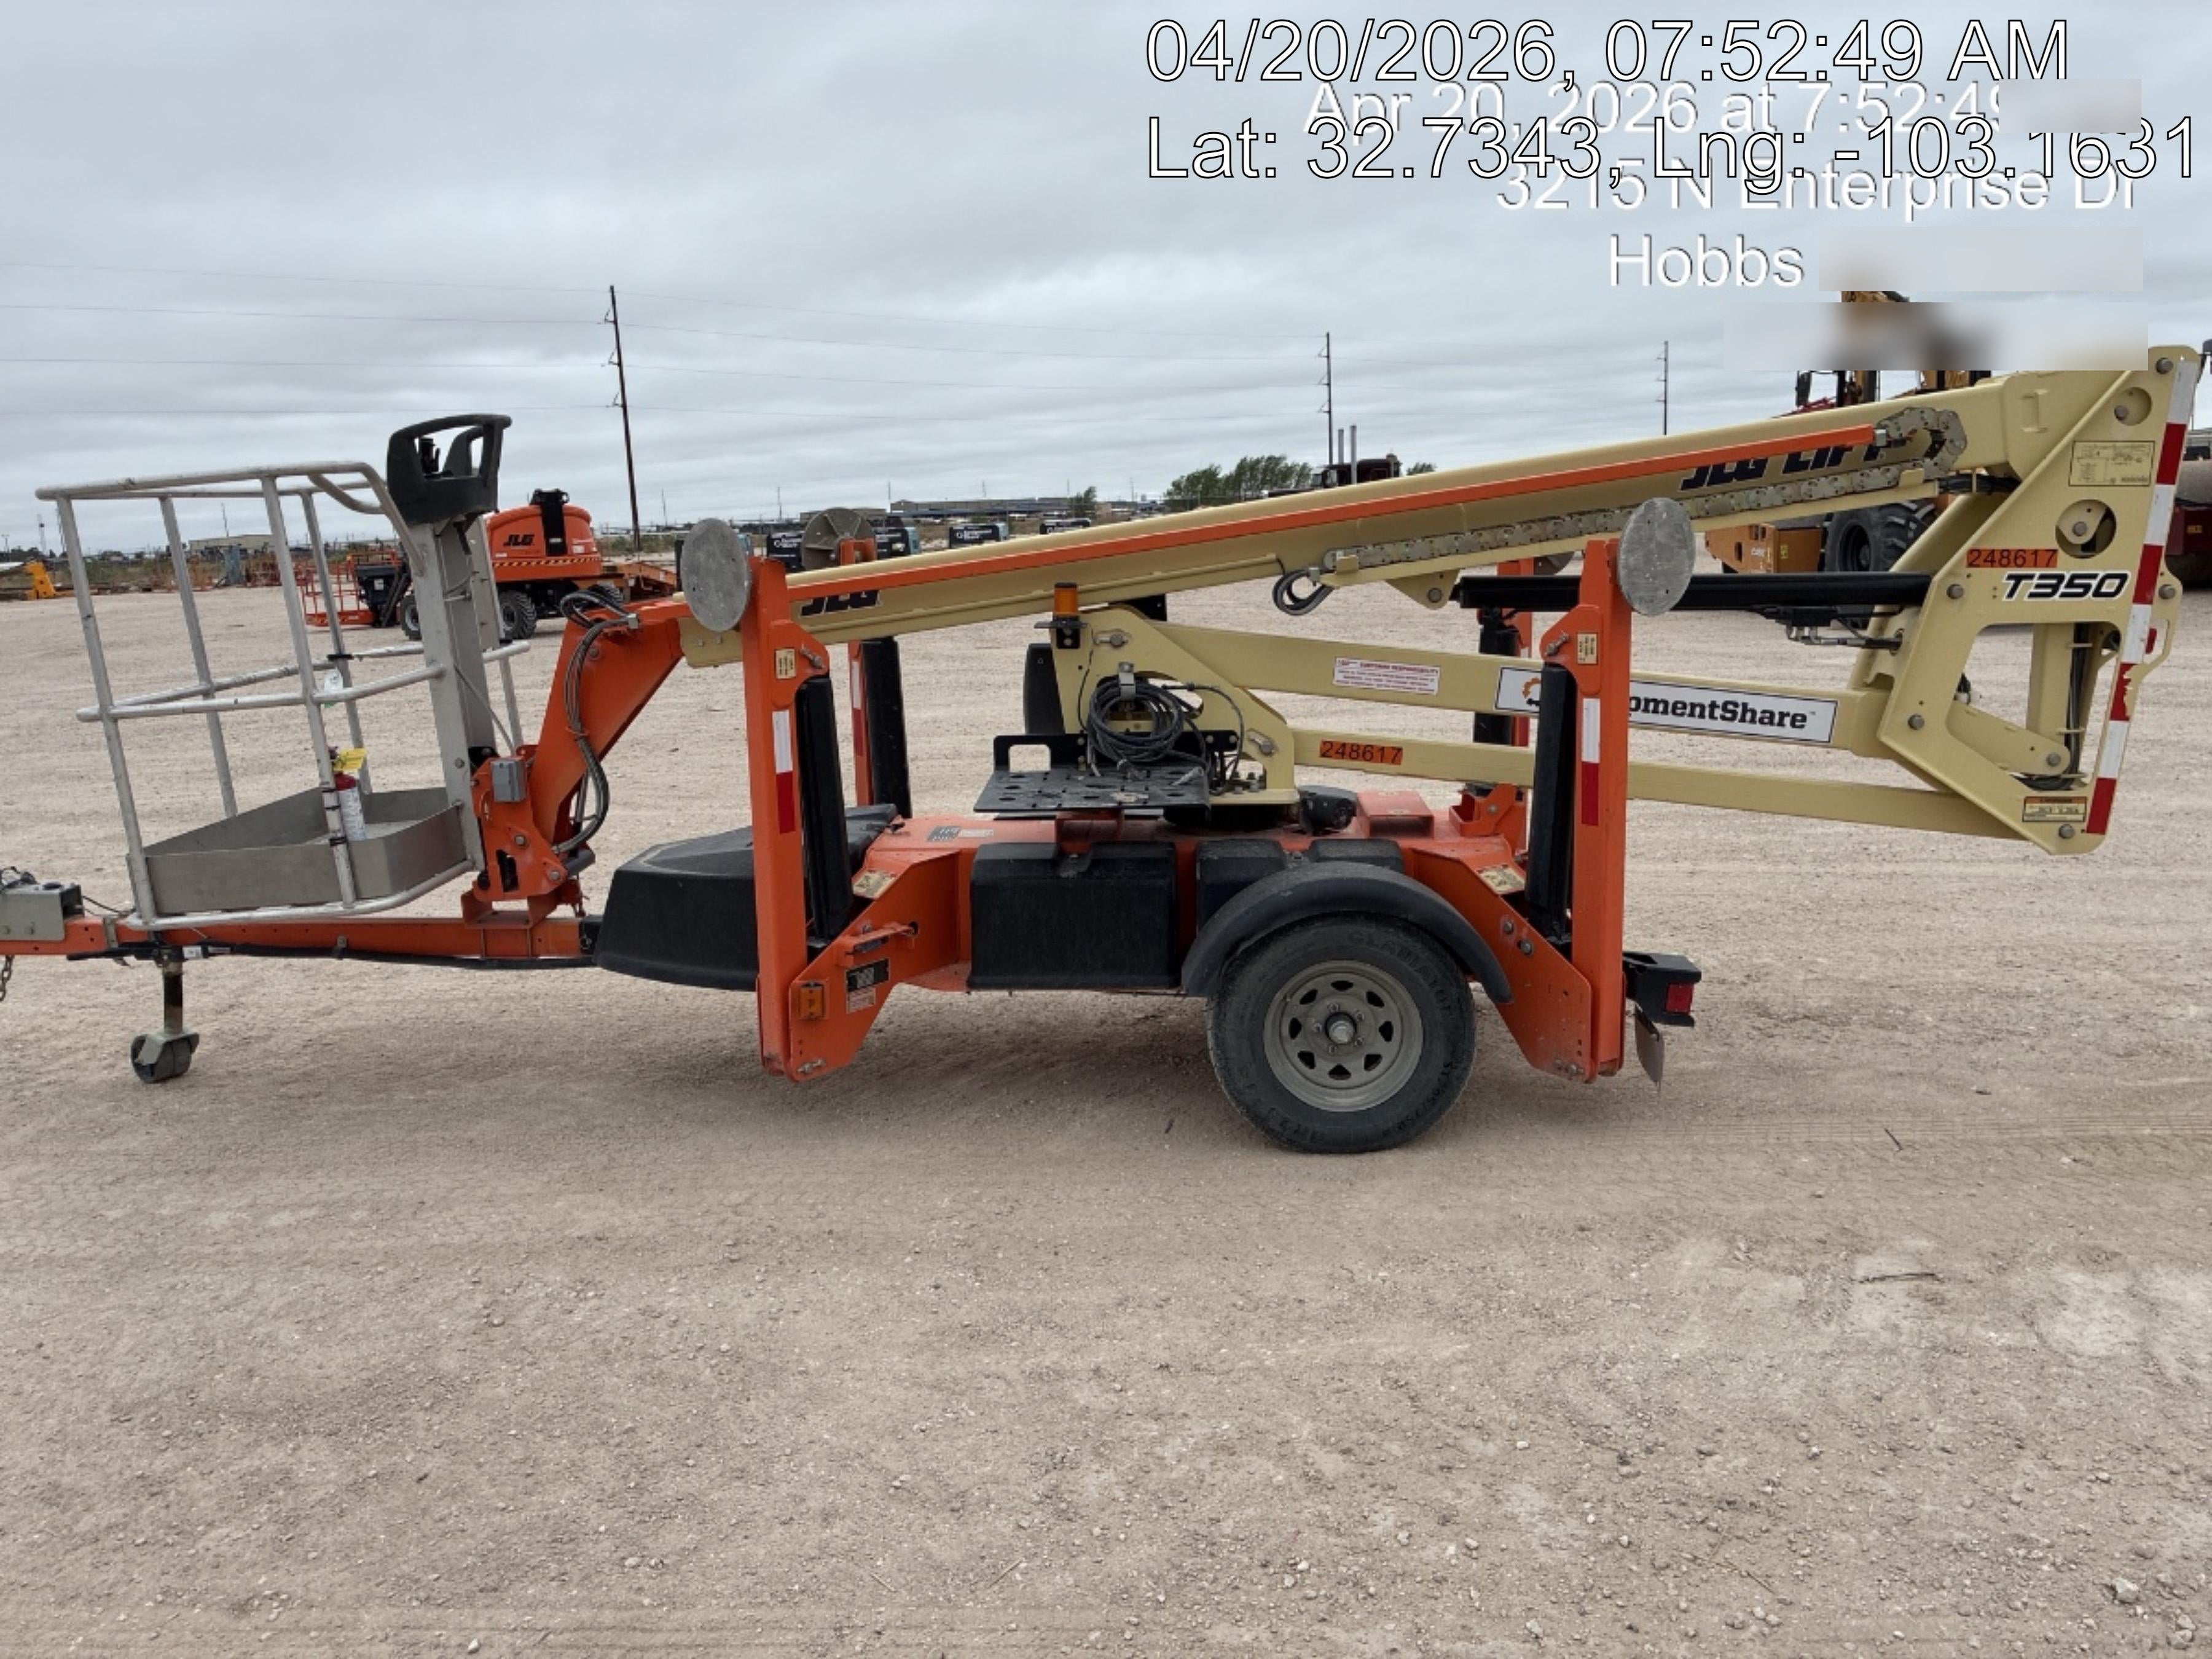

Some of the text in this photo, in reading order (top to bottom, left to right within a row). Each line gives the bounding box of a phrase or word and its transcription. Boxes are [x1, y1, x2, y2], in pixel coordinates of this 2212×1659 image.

[503, 533, 535, 547] JLG
[1968, 549, 2057, 567] 248617
[2002, 570, 2132, 602] T350
[1629, 695, 1808, 729] pmentShare
[1322, 740, 1403, 764] 248617
